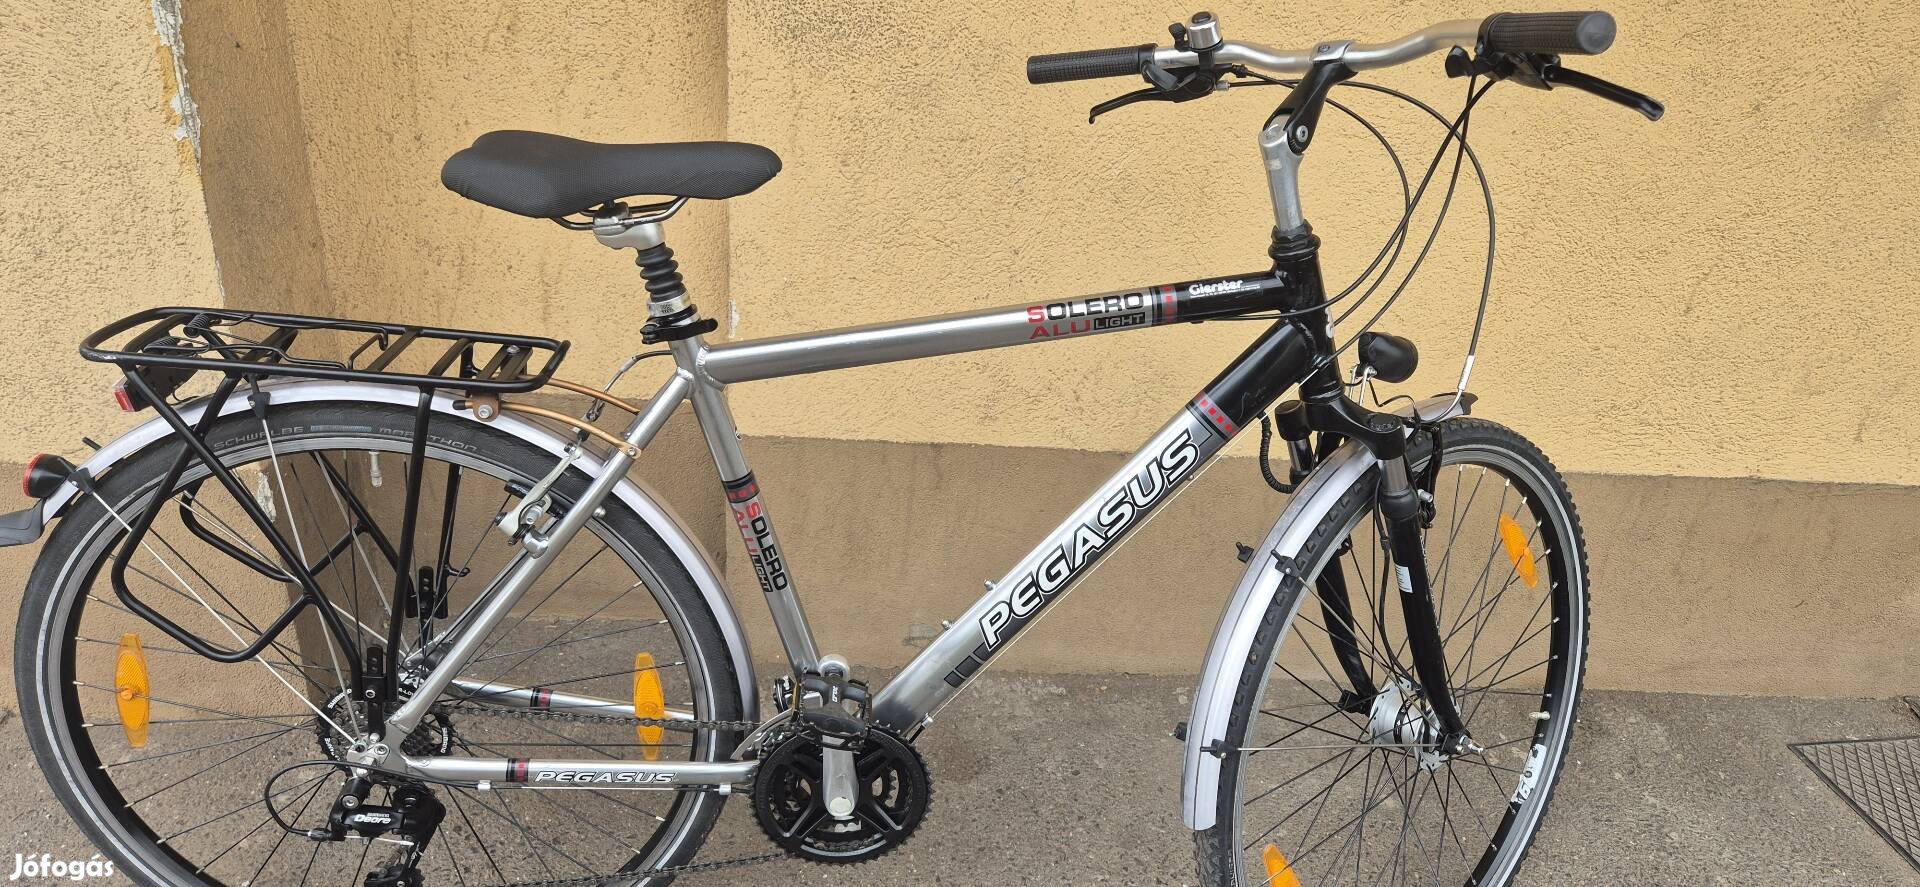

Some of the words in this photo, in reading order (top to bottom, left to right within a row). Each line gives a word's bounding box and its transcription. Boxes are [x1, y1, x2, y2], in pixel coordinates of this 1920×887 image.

[1026, 292, 1144, 324] SOLERO
[1030, 318, 1091, 339] ALU
[1094, 312, 1145, 330] LIGHT
[379, 428, 477, 451] MARTHON
[745, 501, 788, 591] SOLERO
[978, 427, 1200, 651] PEGASUS
[534, 771, 676, 784] PEGASUS
[354, 814, 391, 824] Deore
